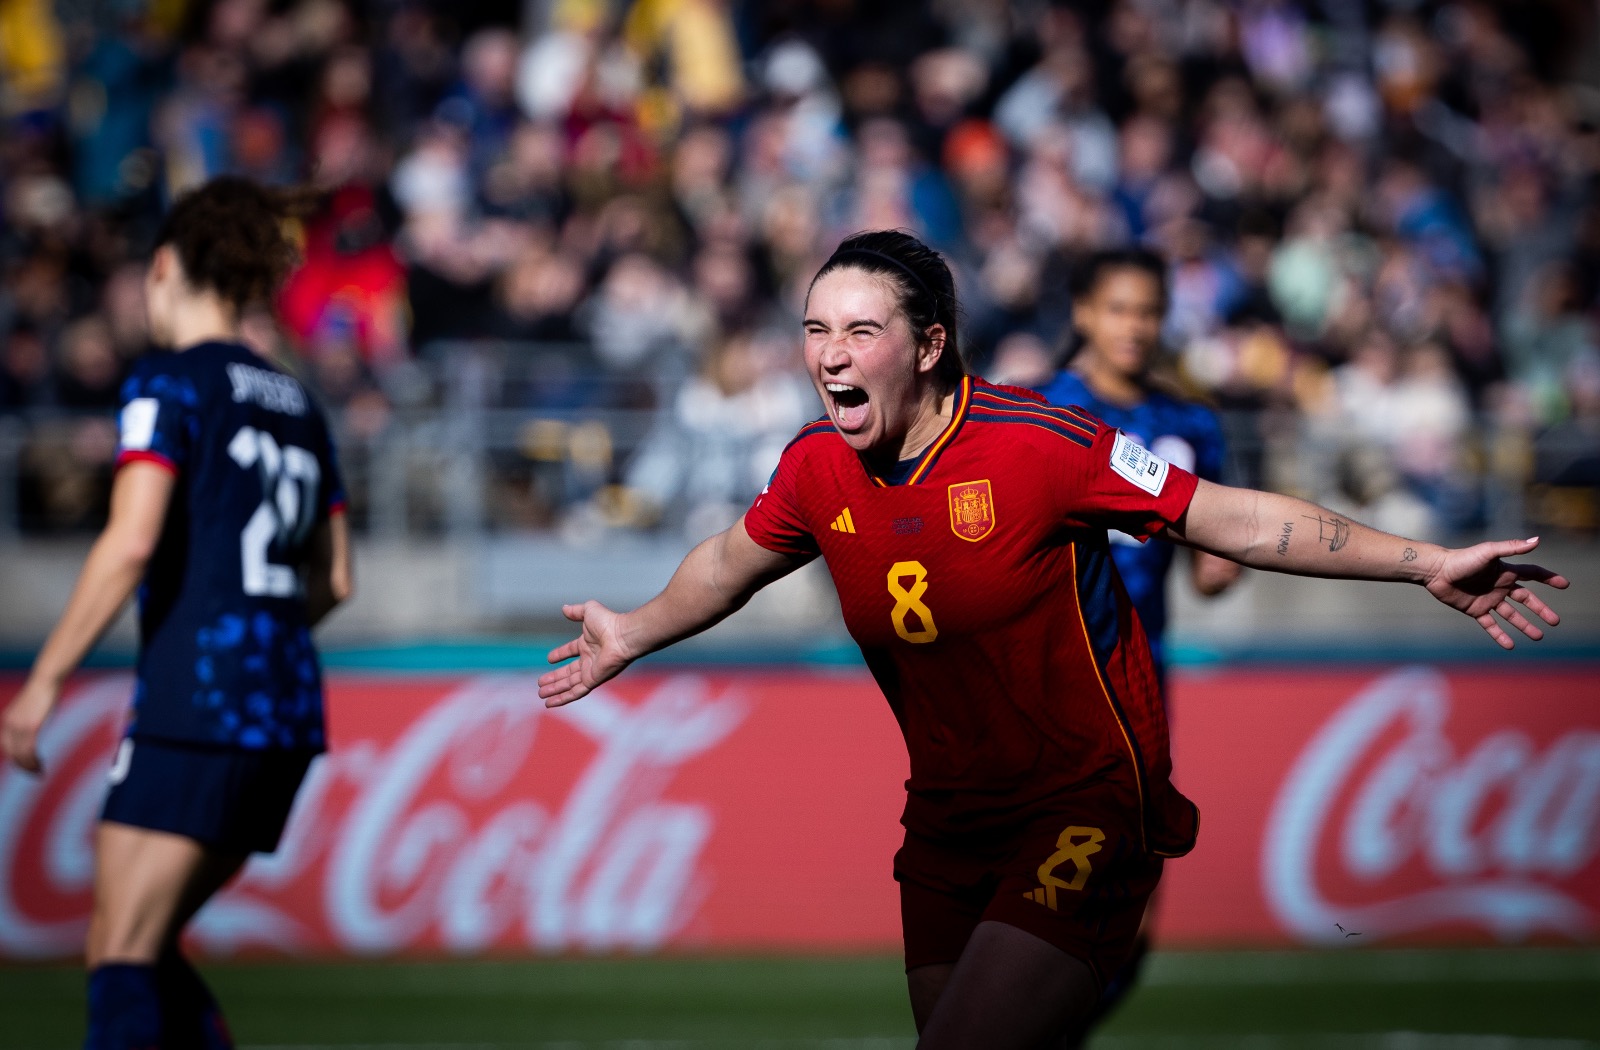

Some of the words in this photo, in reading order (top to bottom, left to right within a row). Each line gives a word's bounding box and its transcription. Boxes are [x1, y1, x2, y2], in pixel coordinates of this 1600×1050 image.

[1126, 444, 1142, 470] UNITES
[226, 425, 321, 597] 20
[887, 560, 939, 644] 8
[1037, 825, 1106, 892] 8
